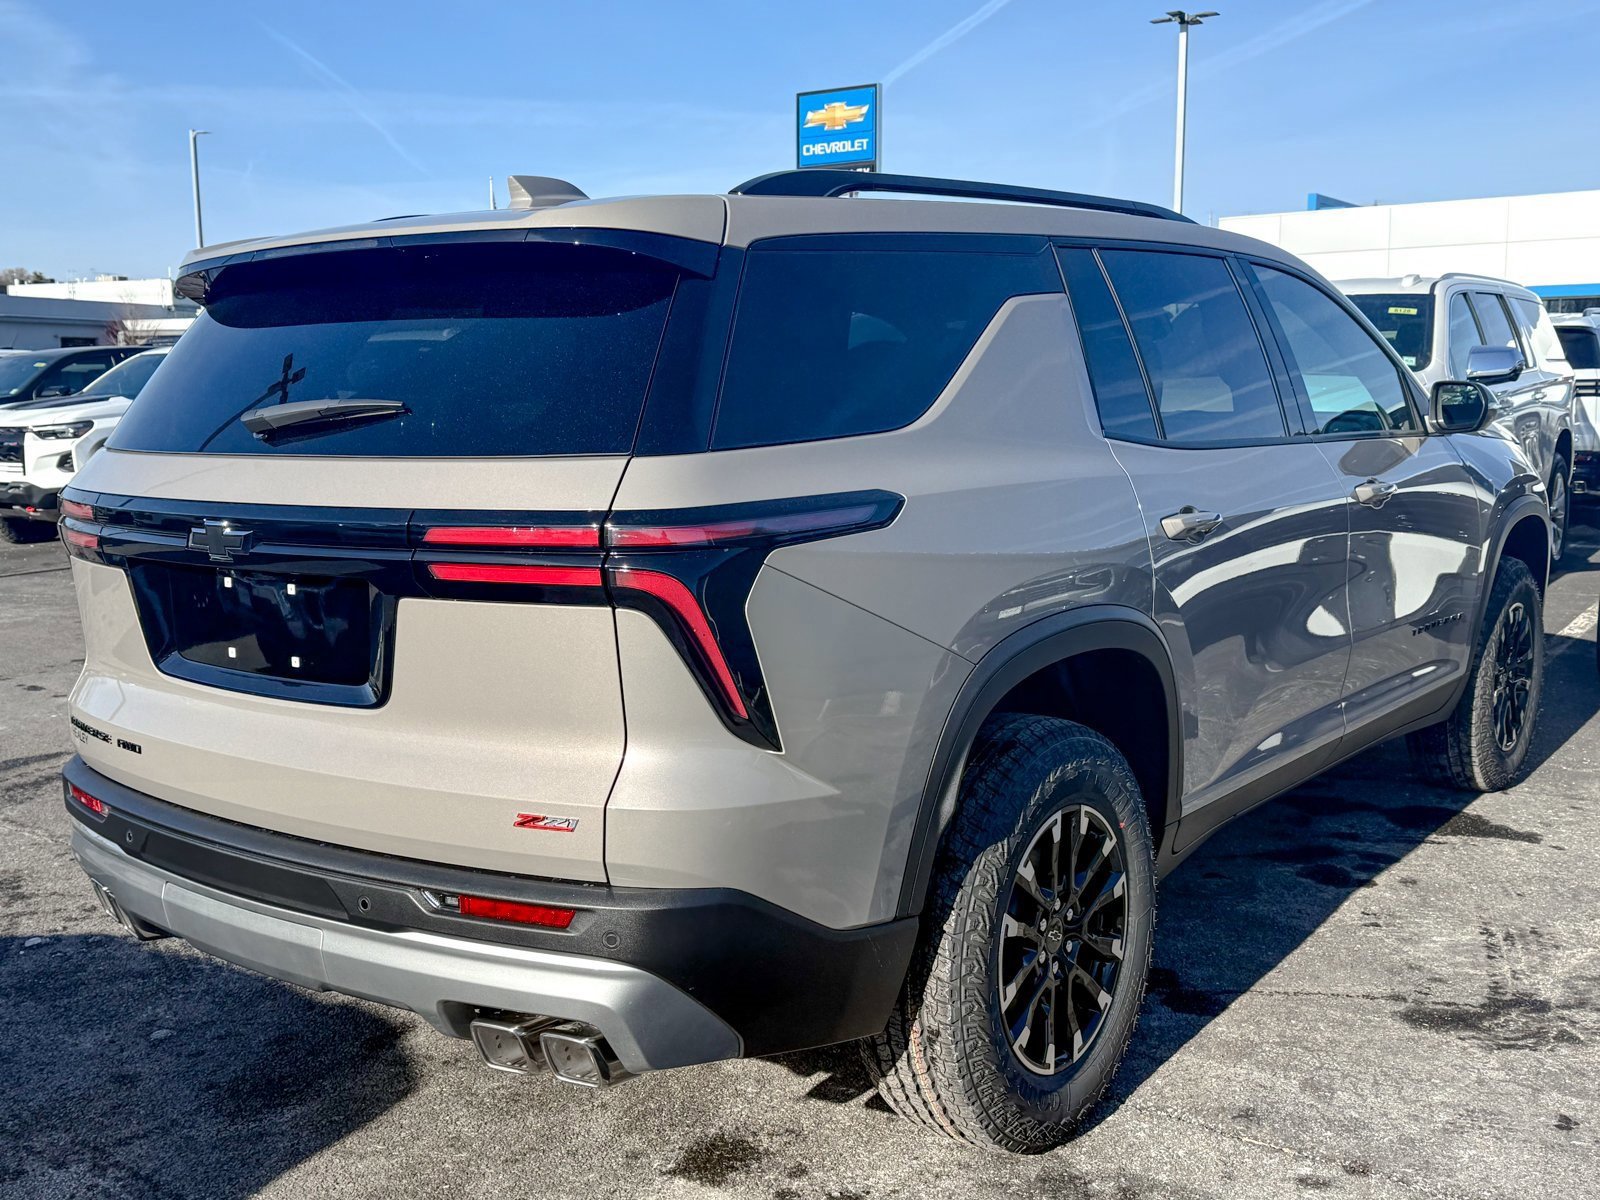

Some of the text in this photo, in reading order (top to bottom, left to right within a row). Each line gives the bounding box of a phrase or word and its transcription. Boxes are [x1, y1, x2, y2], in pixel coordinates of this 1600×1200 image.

[802, 139, 869, 156] CHEVROLET
[117, 738, 142, 755] AWD
[513, 812, 579, 833] Z71
